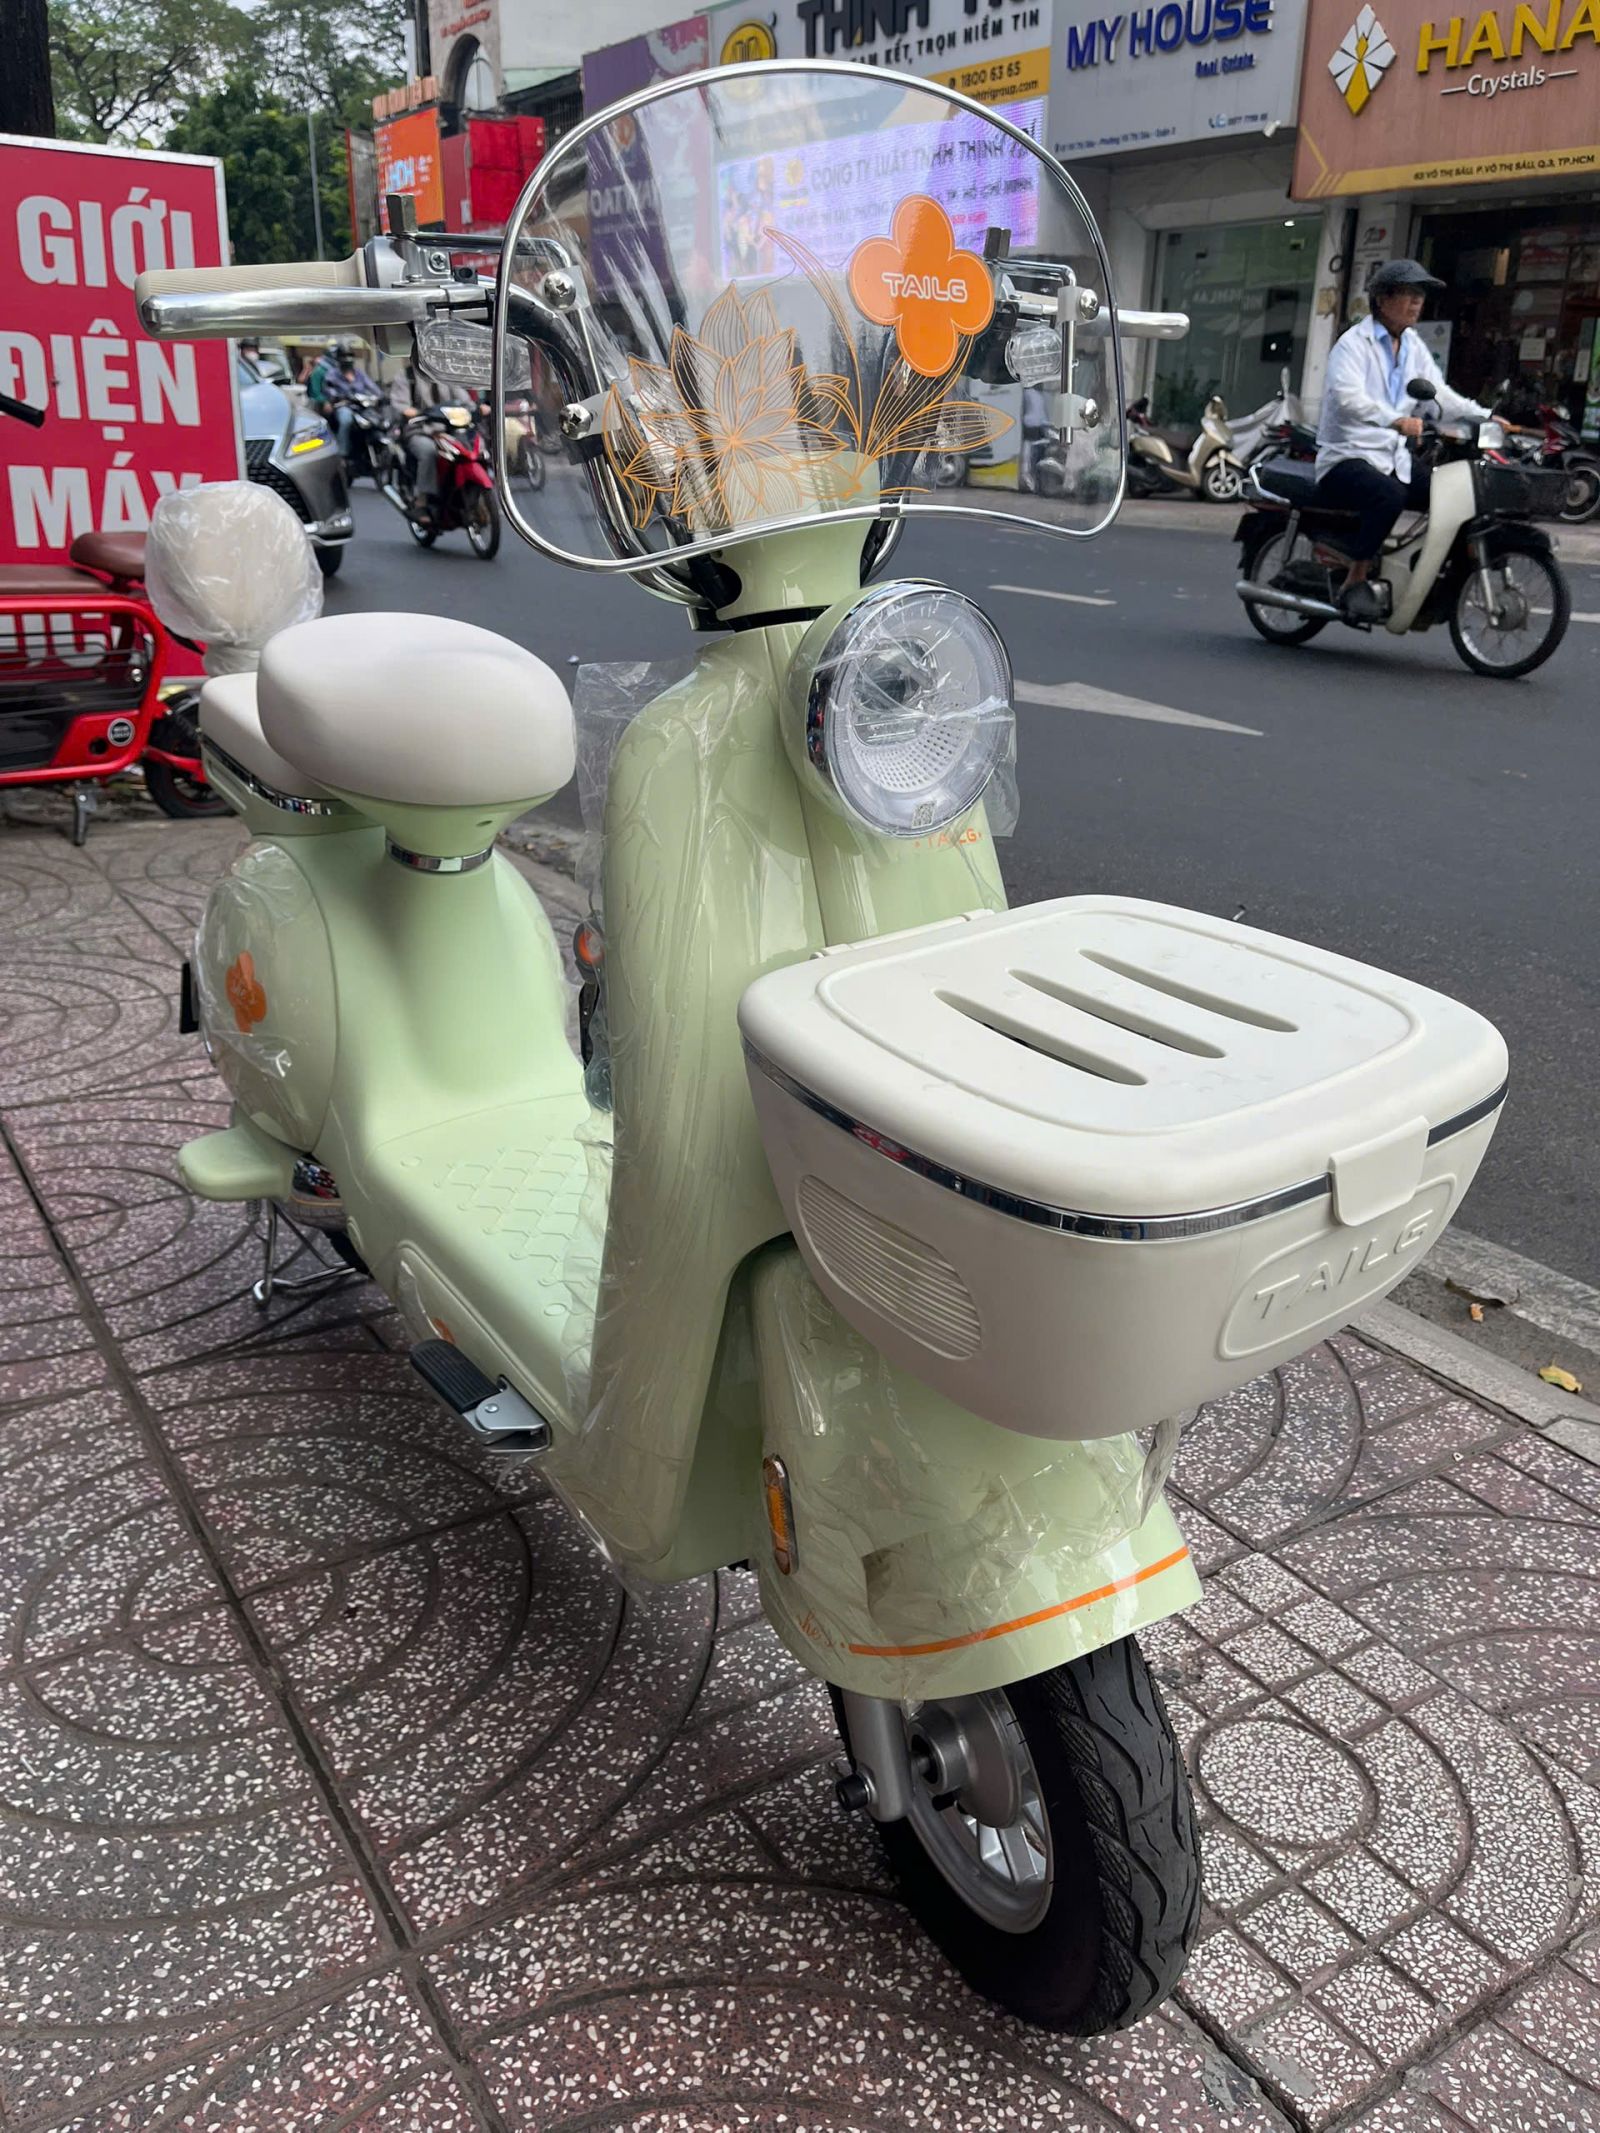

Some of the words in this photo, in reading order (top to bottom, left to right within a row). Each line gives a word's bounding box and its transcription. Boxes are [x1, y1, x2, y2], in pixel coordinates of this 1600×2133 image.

[1012, 8, 1040, 32] TIN
[1067, 16, 1124, 70] MY
[1129, 0, 1274, 57] HOUSE
[1416, 0, 1600, 73] HANA
[1467, 66, 1546, 98] Crystals
[17, 187, 195, 290] GIỚI
[881, 272, 968, 303] TAILG
[0, 318, 201, 441] ĐIỆN
[1254, 1209, 1434, 1320] TAILG
